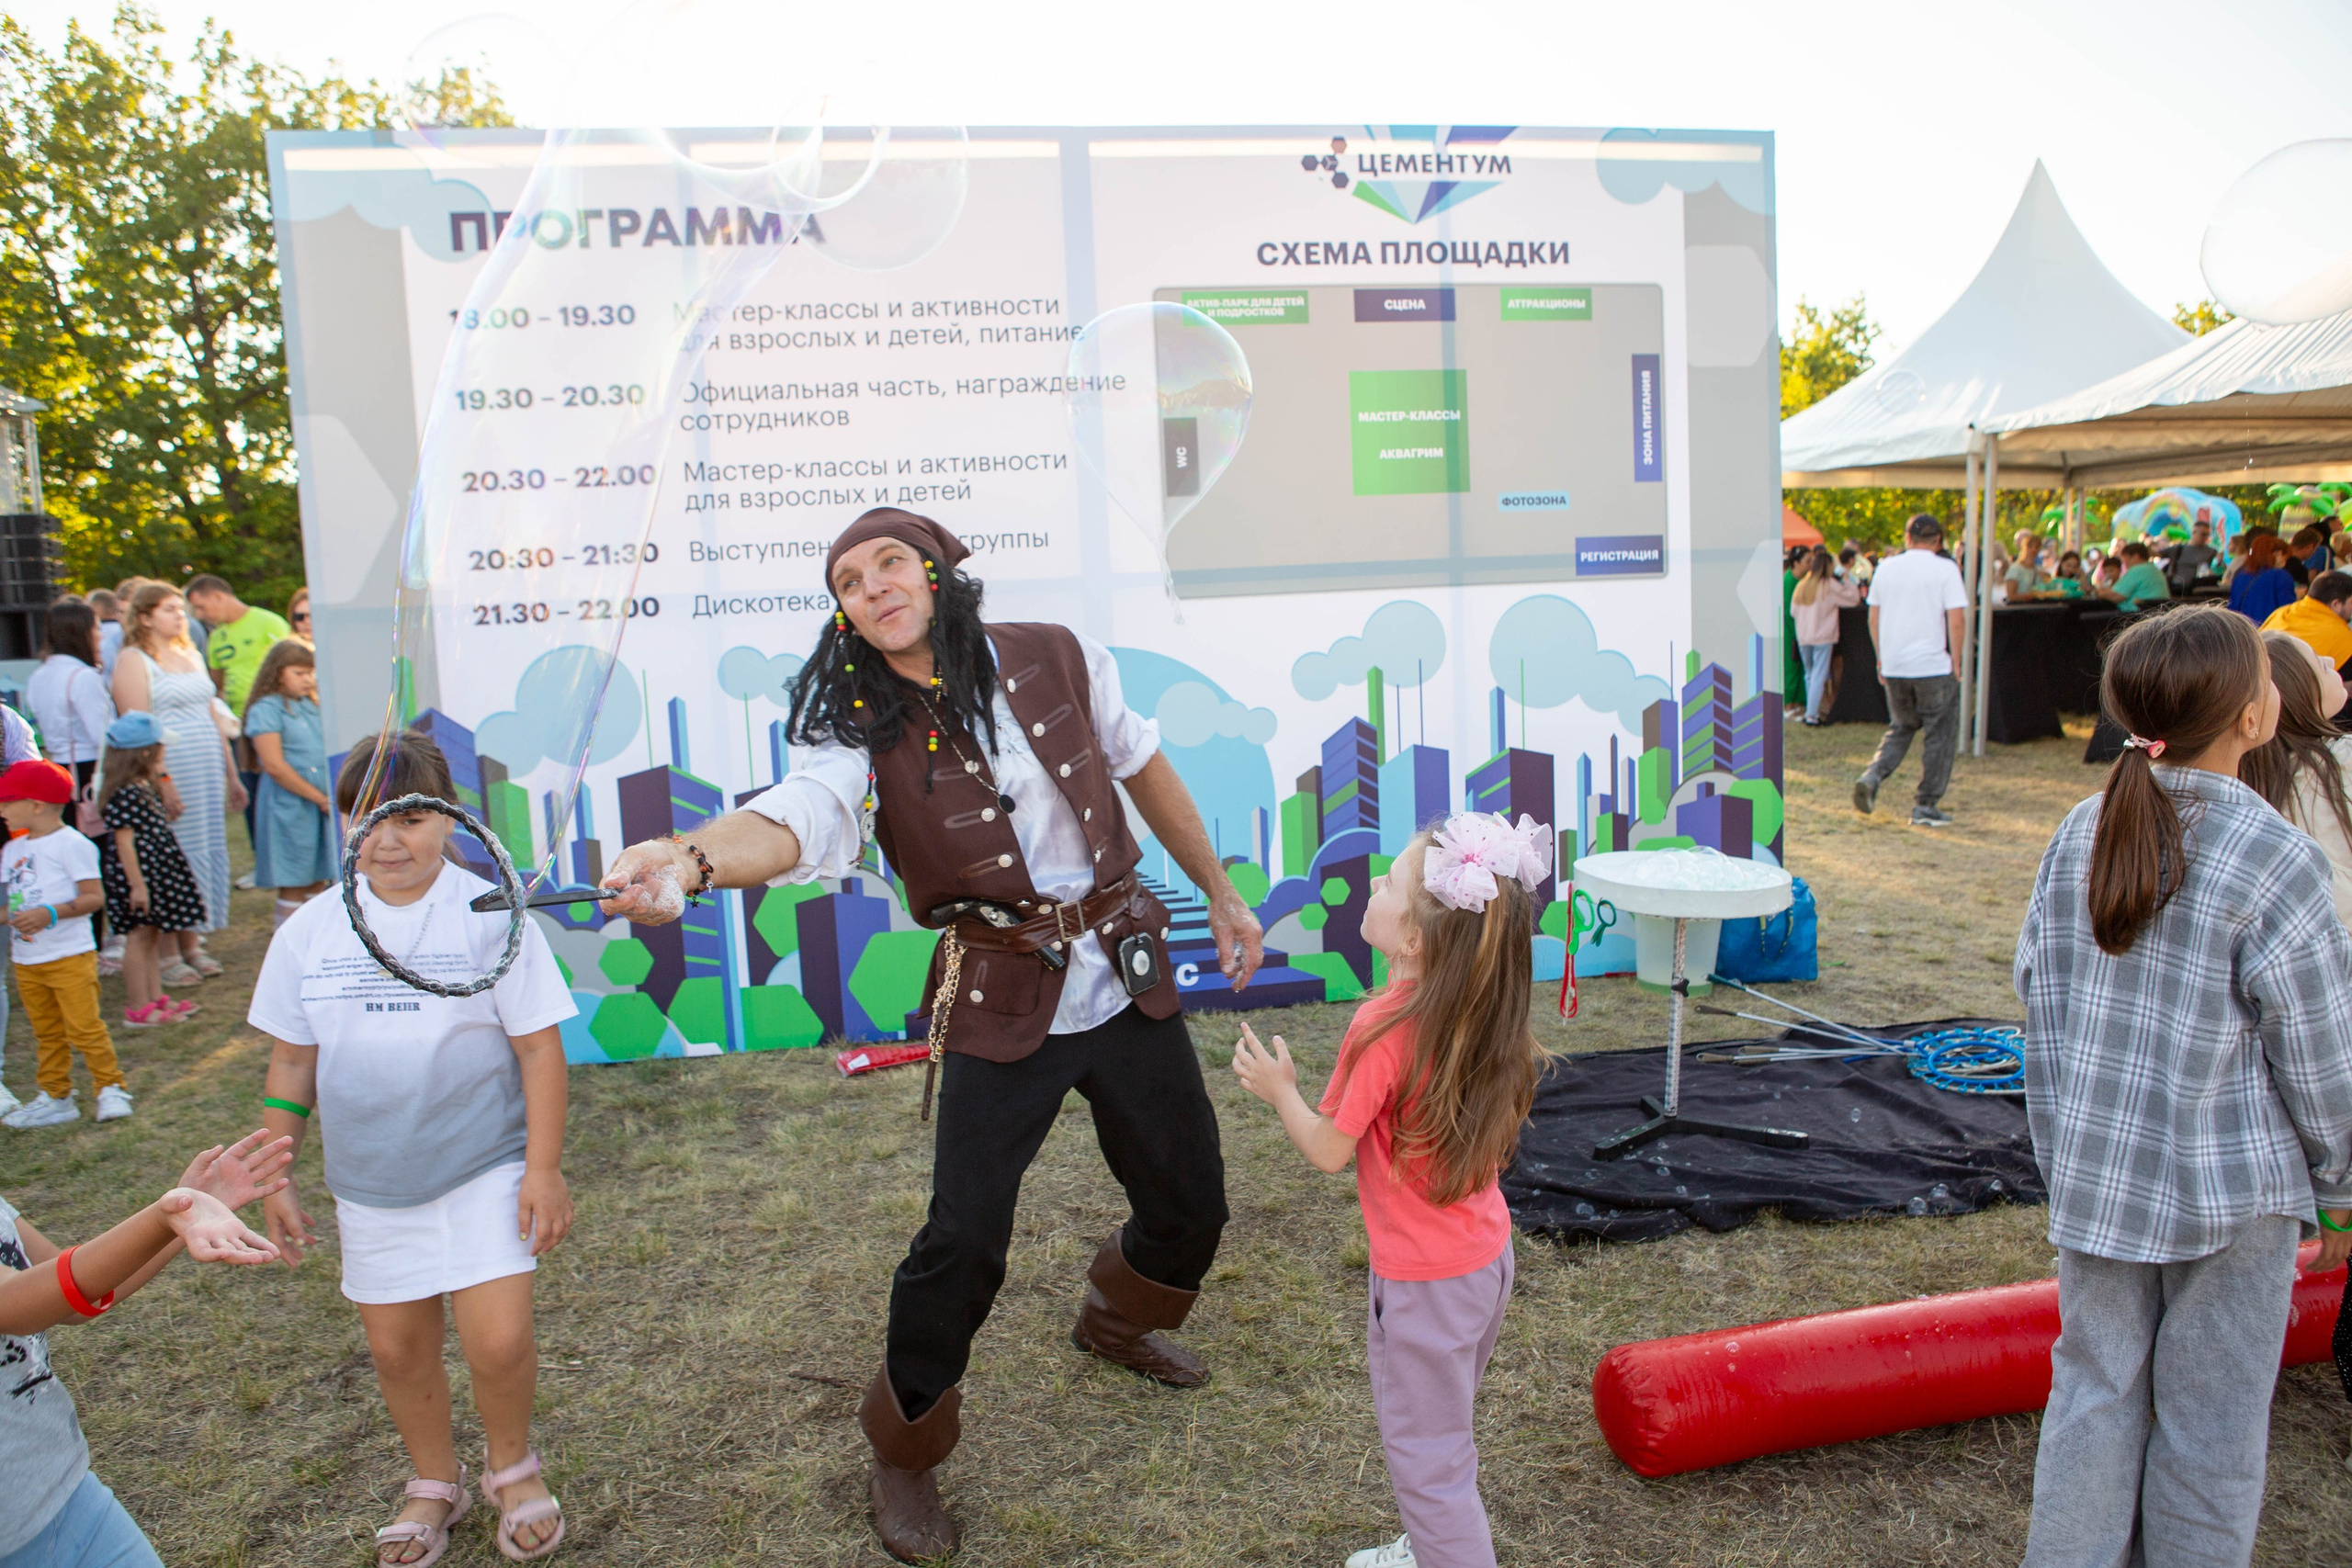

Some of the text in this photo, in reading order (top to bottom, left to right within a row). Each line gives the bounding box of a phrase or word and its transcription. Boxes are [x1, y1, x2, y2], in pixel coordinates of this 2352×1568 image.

[1358, 153, 1512, 176] ЦЕМЕНТУМ
[449, 208, 826, 253] ПРОГРАММА
[1257, 242, 1571, 268] СХЕМА ПЛОЩАДКИ
[888, 302, 903, 317] и
[911, 299, 1060, 317] активности
[1186, 295, 1305, 308] АКТИВ-ПАРК ДЛЯ ДЕТЕЙ
[1207, 307, 1285, 318] И ПОДРОСТКОВ
[1384, 299, 1426, 311] СЦЕНА
[1508, 299, 1587, 310] АТТРАКЦИОНЫ
[448, 306, 529, 330] 18.00
[558, 304, 636, 326] 19.30
[729, 330, 856, 354] взрослых
[865, 329, 879, 344] и
[888, 323, 971, 348] детей,
[979, 324, 1085, 344] питание
[456, 388, 533, 411] 19.30
[561, 384, 645, 407] 20.30
[683, 374, 1126, 407] Официальная часть, награждение
[680, 410, 850, 434] сотрудников
[1358, 410, 1461, 423] МАСТЕР-КЛАССЫ
[1641, 369, 1653, 466] ЗОНА ПИТАНИЯ
[1176, 446, 1188, 468] WC
[1379, 447, 1443, 459] АКВАГРИМ
[462, 469, 546, 492] 20.30
[574, 465, 656, 488] 22.00
[684, 453, 1067, 484] Мастер-классы и активности
[684, 479, 971, 513] для взрослых и детей
[1501, 496, 1566, 506] ФОТОЗОНА
[469, 548, 554, 570] 20:30
[582, 543, 659, 566] 21:30
[689, 539, 831, 564] Выступлен
[1580, 549, 1659, 563] РЕГИСТРАЦИЯ
[473, 603, 549, 626] 21.30
[578, 597, 660, 620] 22.00
[693, 593, 830, 619] Дискотека
